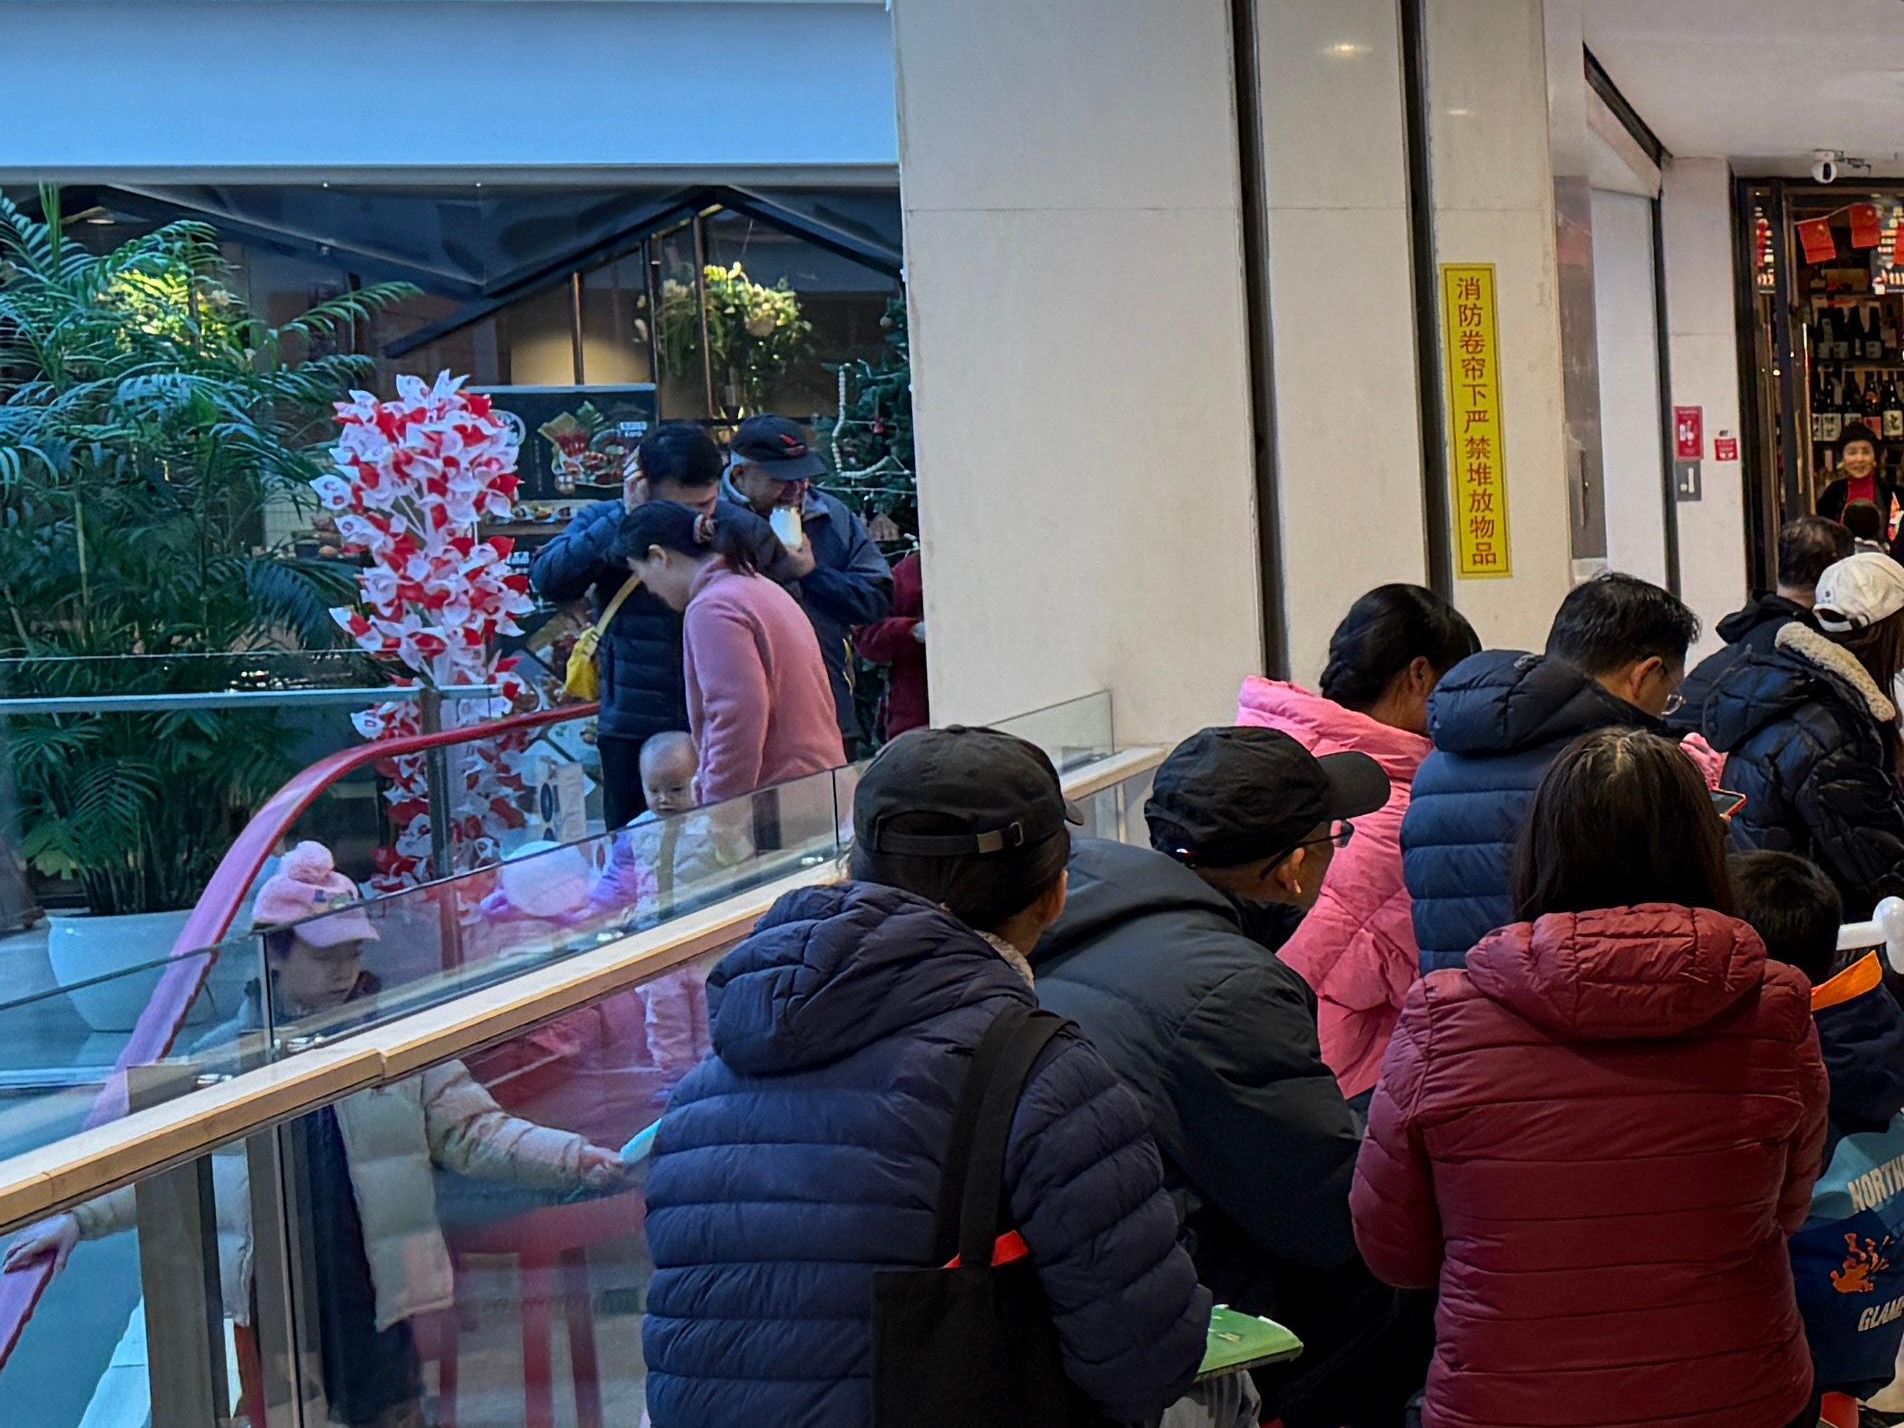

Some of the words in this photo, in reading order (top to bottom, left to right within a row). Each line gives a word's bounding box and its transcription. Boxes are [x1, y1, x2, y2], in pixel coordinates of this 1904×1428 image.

[1456, 276, 1498, 566] 消防卷帘下严禁堆放物品
